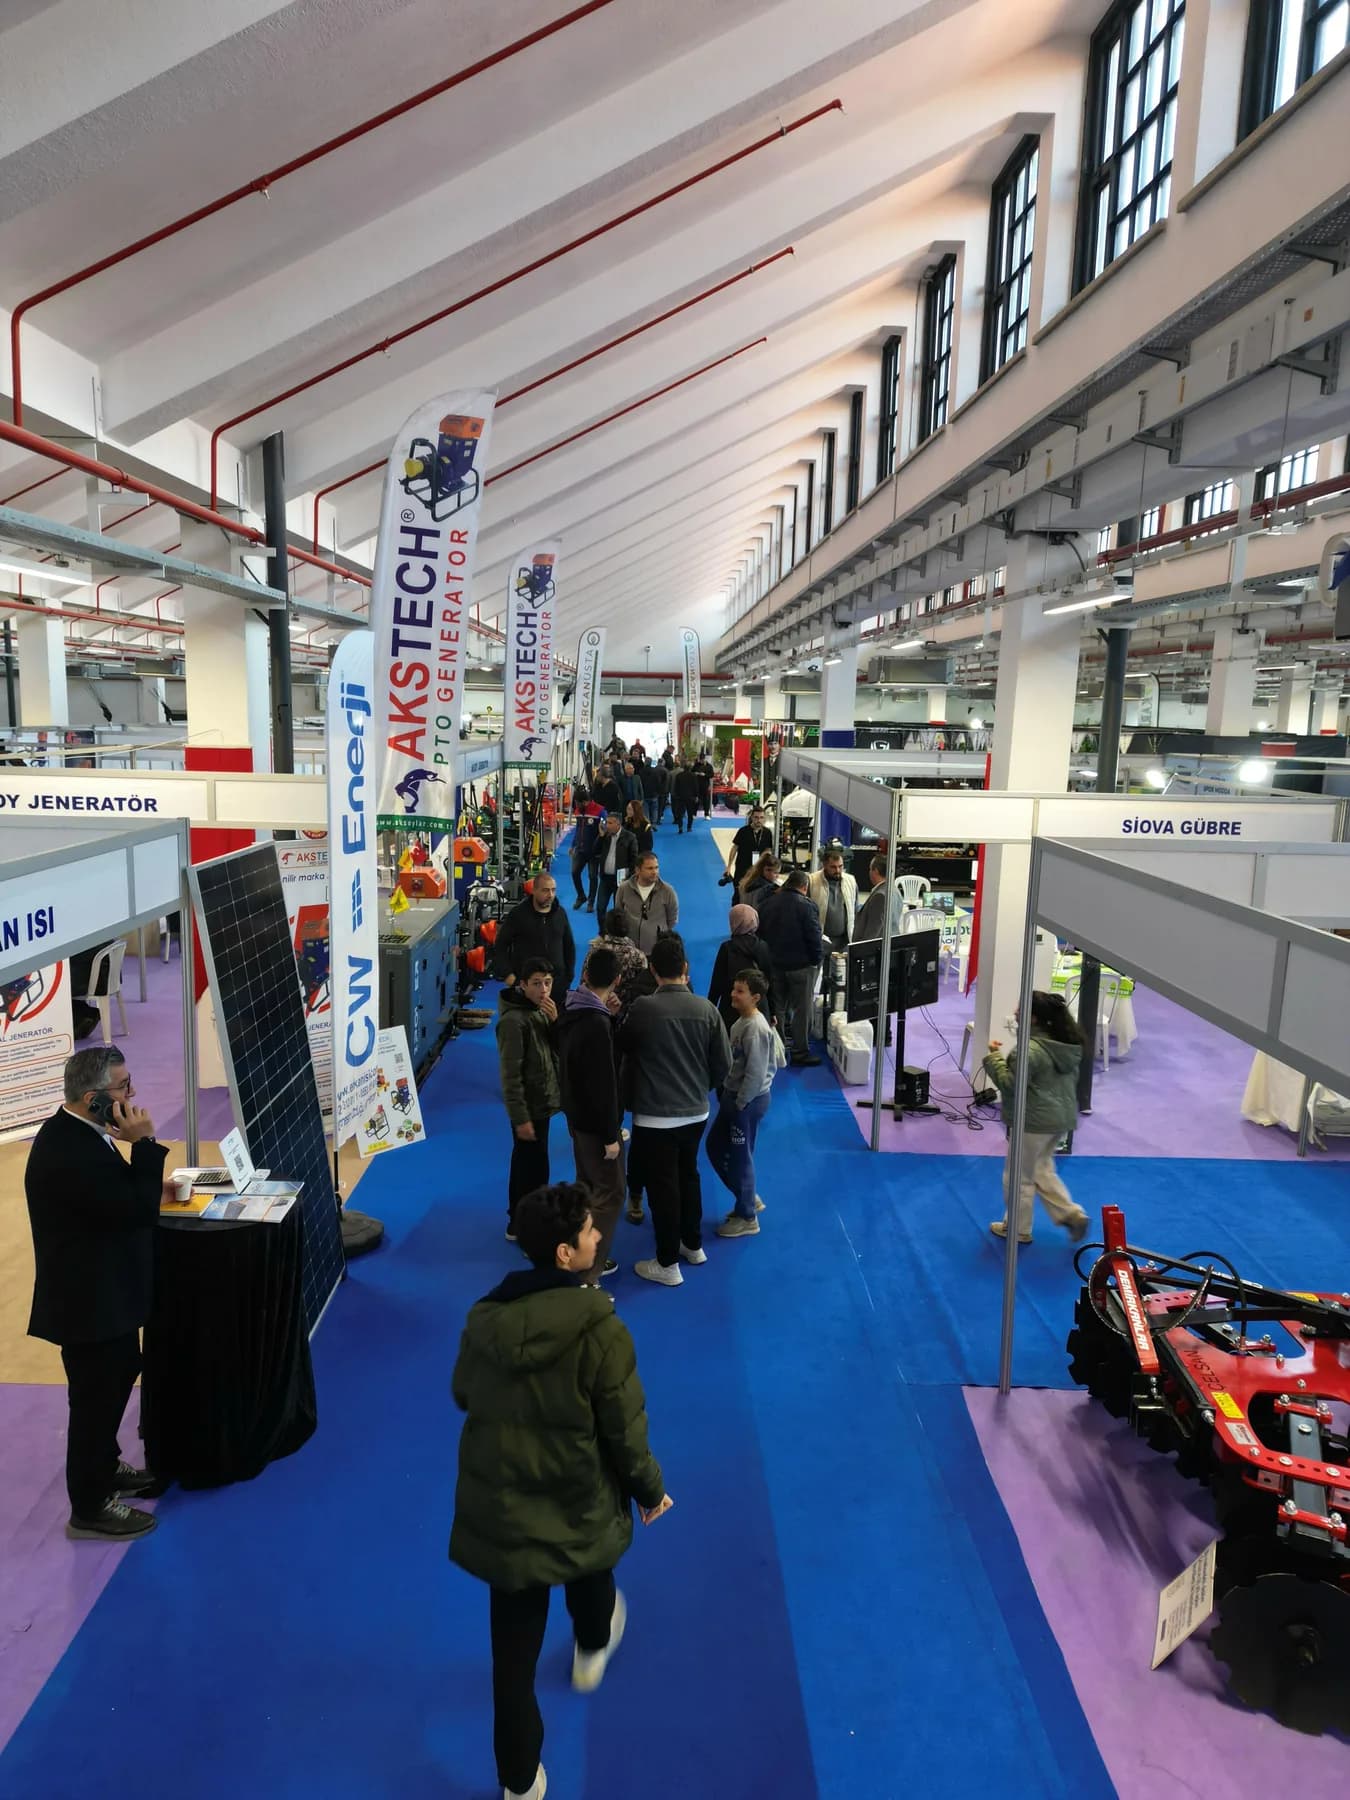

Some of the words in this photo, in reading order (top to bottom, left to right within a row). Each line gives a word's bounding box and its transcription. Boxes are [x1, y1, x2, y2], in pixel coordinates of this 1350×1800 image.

[436, 529, 468, 702] GENERATOR
[539, 611, 552, 702] GENERATOR
[580, 649, 594, 734] MERCANUSTA
[433, 715, 452, 765] PTO
[538, 707, 549, 734] PTO
[28, 794, 158, 812] JENERATÖR
[1122, 817, 1174, 835] SİOVA
[1180, 818, 1242, 836] GÜBRE
[299, 872, 325, 881] marka
[27, 906, 54, 941] ISI
[1117, 1269, 1150, 1351] DEMİRKANLAR
